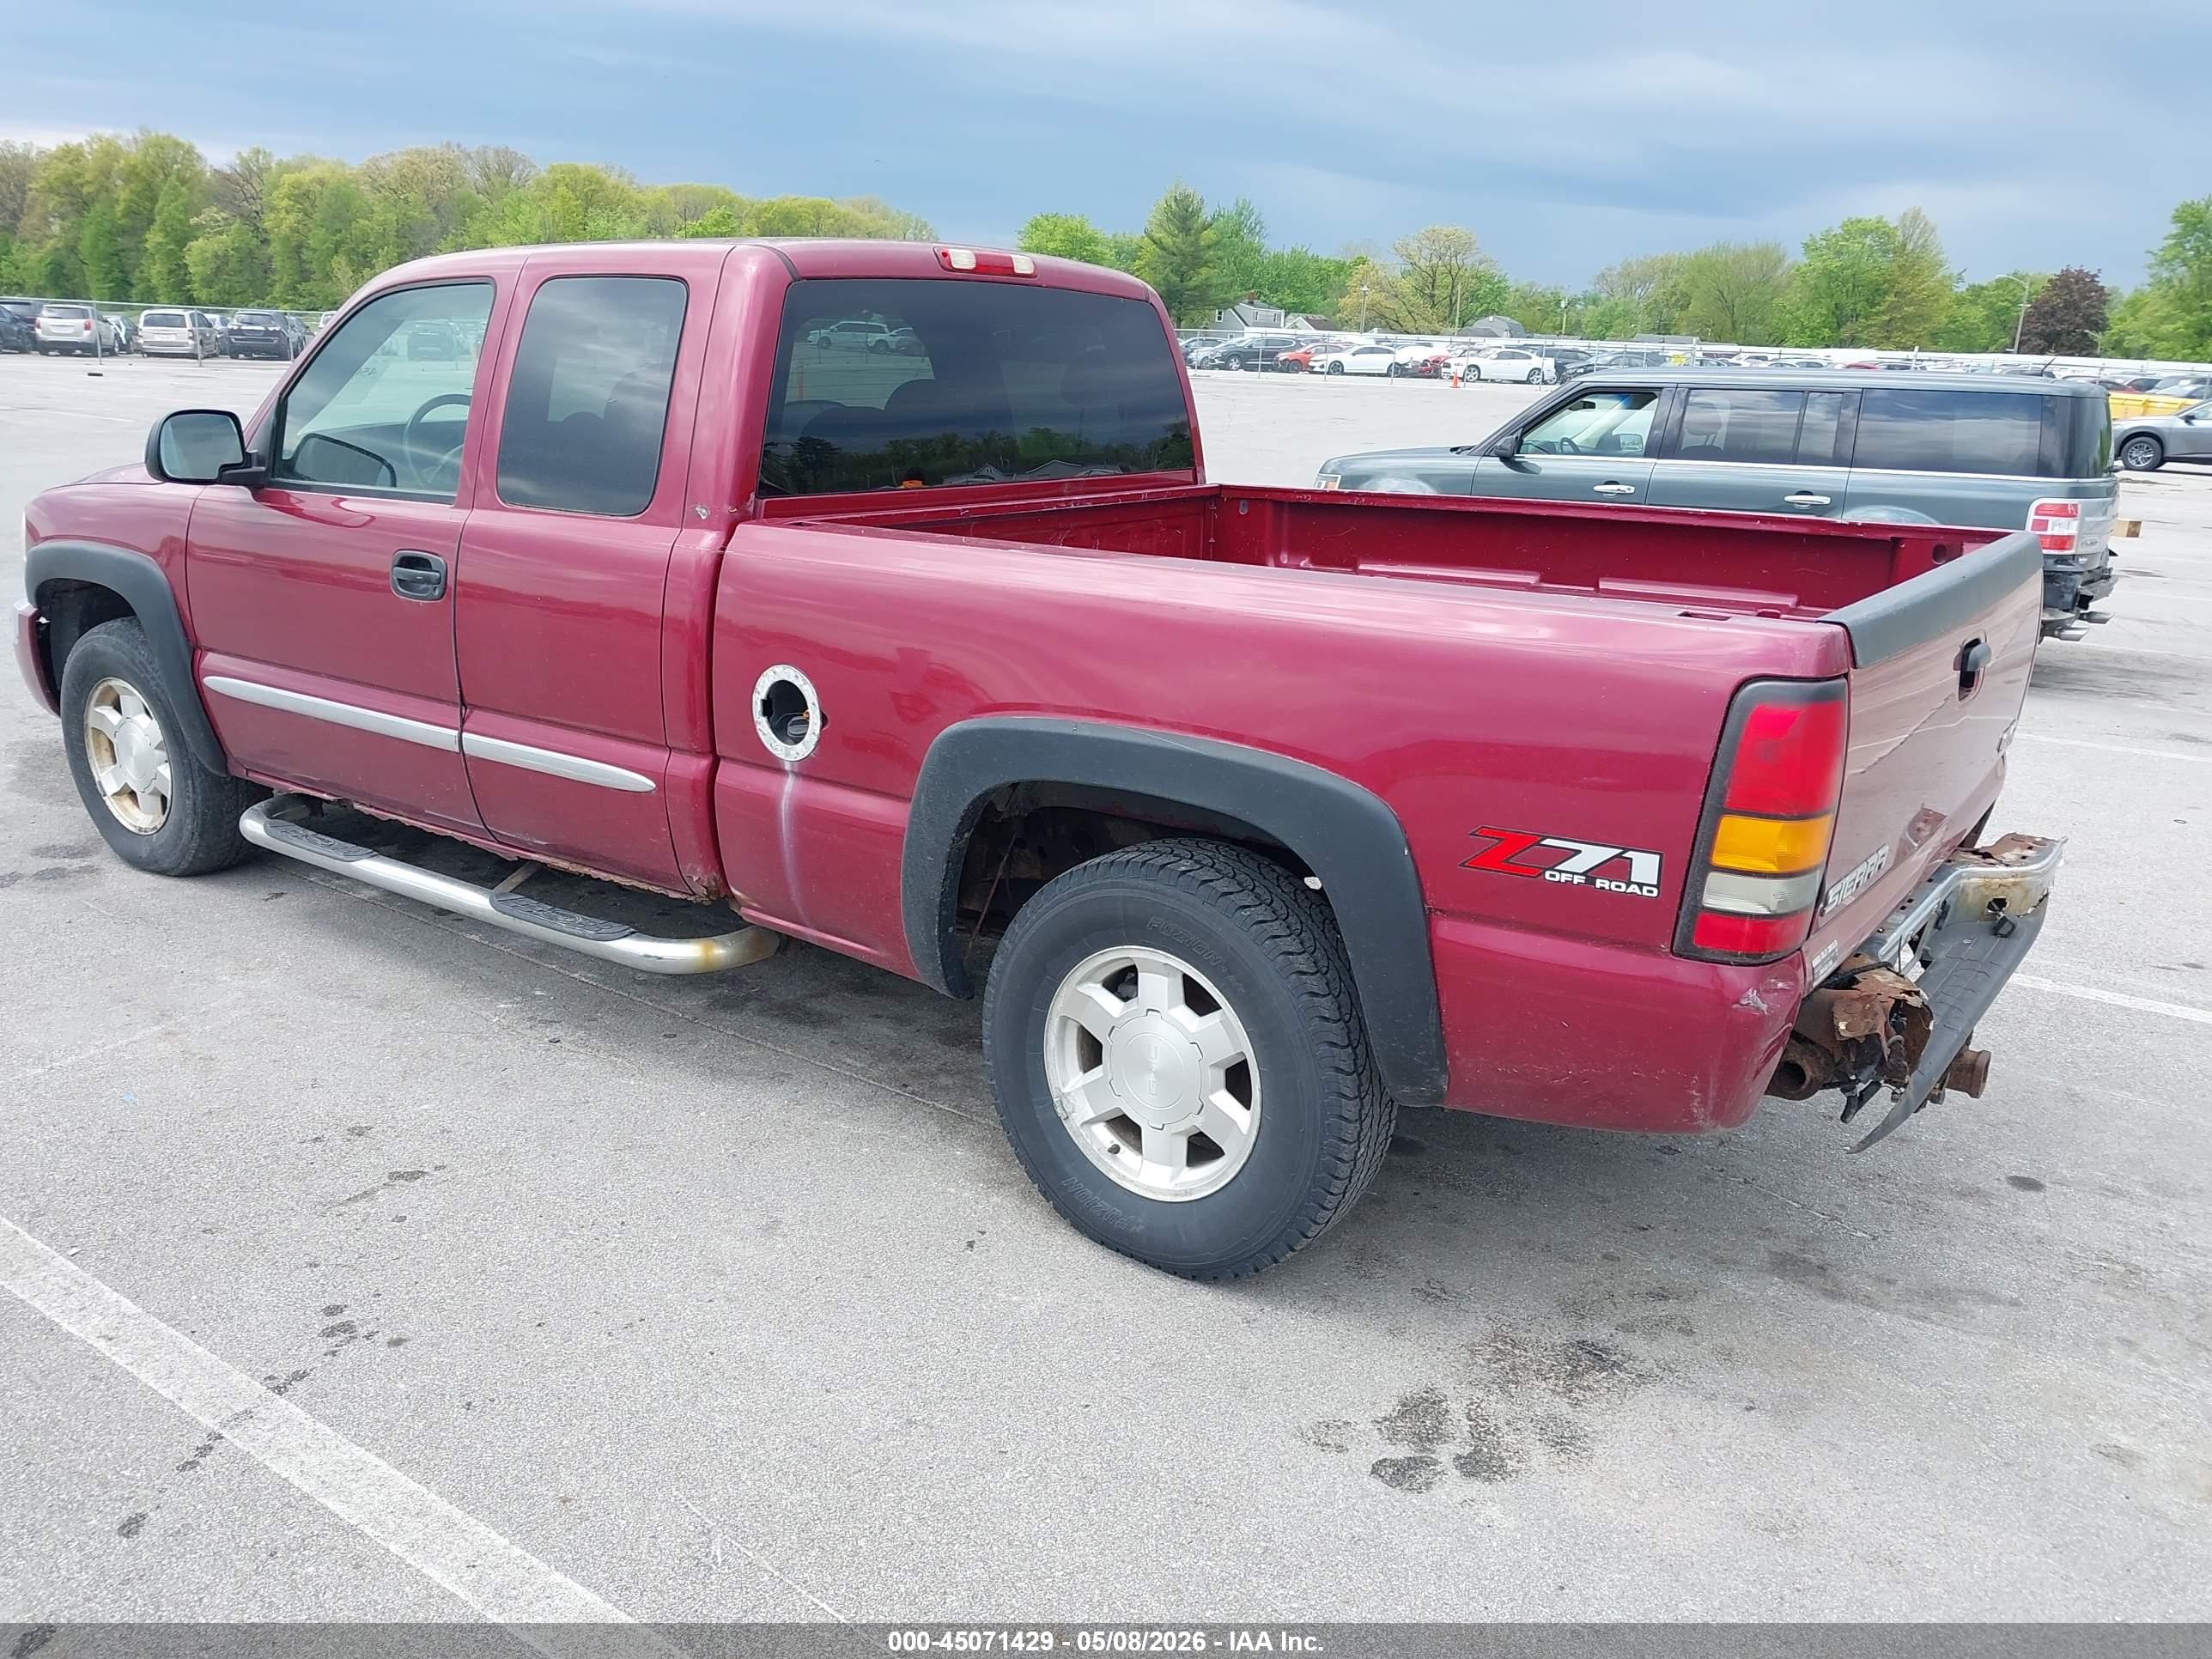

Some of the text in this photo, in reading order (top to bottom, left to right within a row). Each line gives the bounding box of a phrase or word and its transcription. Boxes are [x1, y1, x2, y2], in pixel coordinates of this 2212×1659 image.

[1458, 825, 1663, 885] Z71
[1544, 869, 1659, 897] OFF ROAD
[1824, 843, 1889, 916] SIERRA
